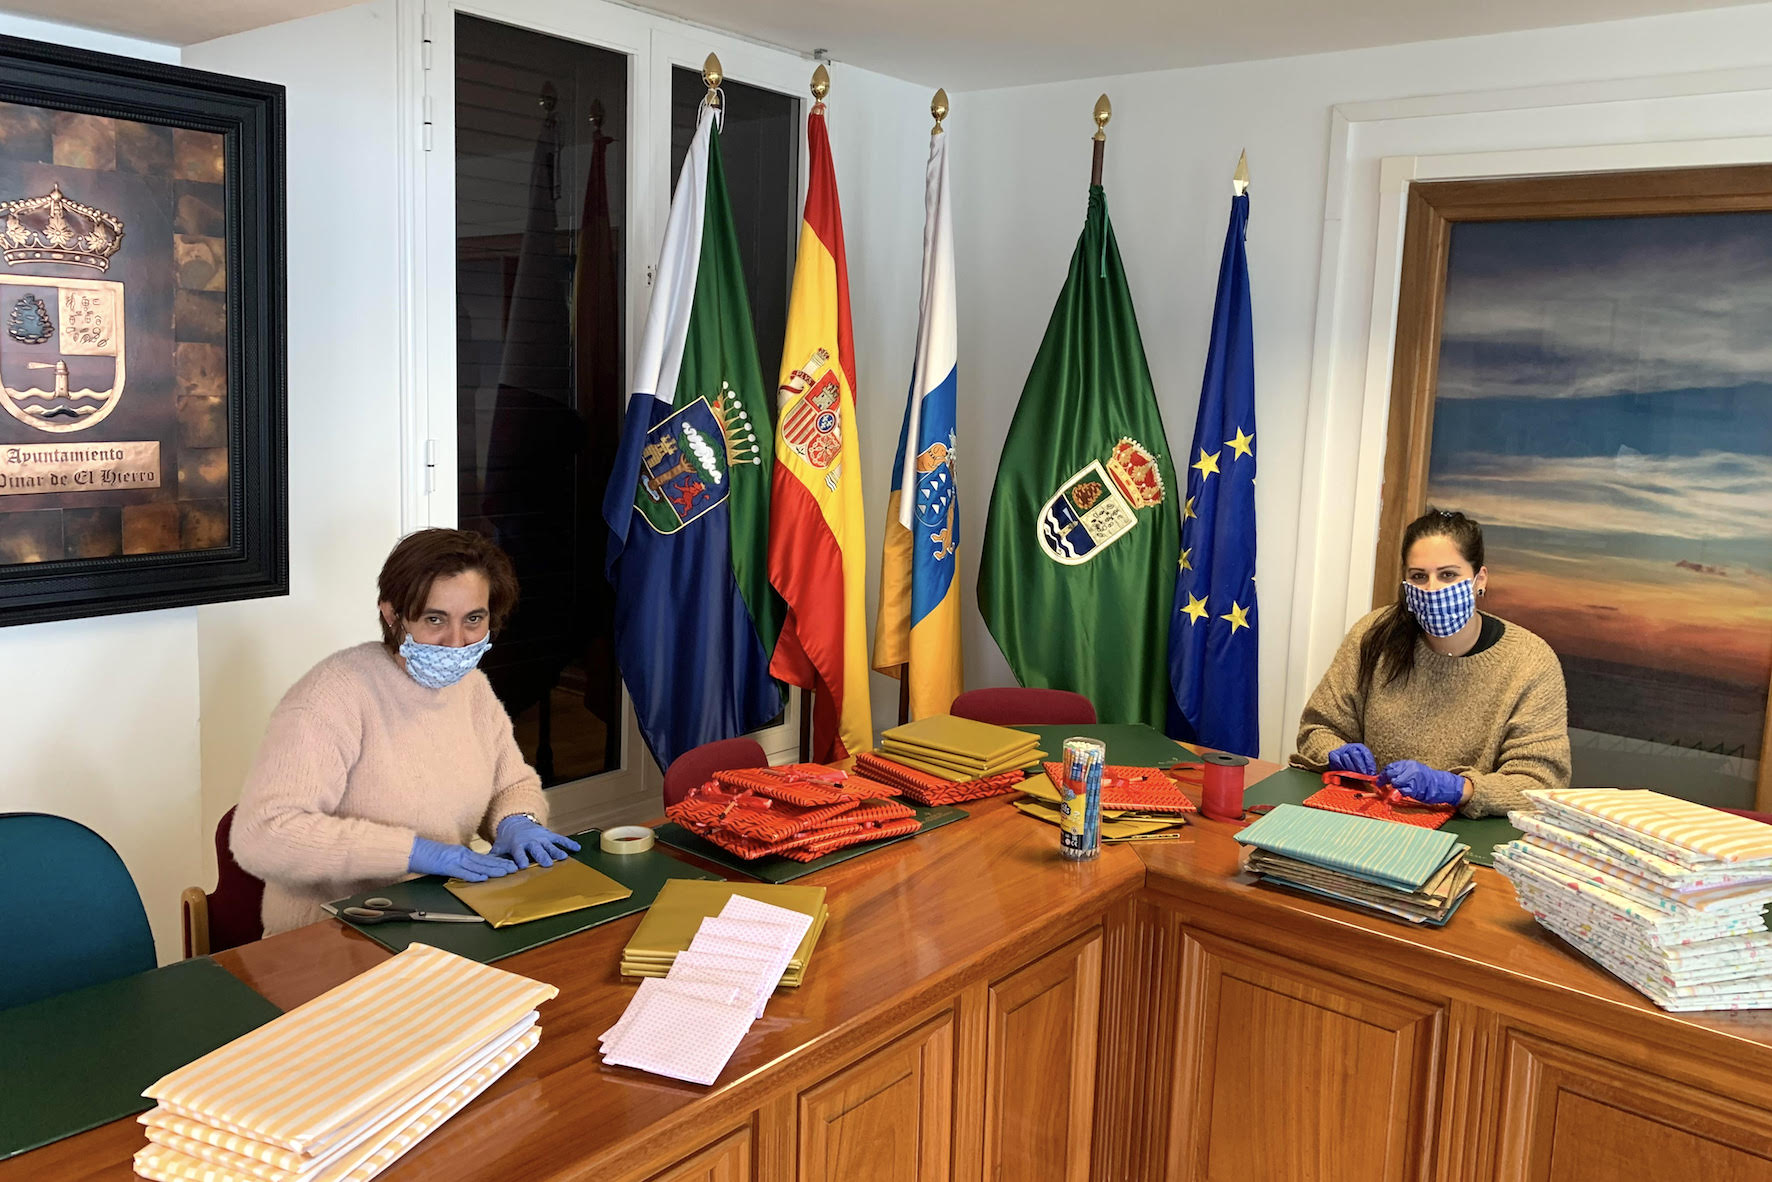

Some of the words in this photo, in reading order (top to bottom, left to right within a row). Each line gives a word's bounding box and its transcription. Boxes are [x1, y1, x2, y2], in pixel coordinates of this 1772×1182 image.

[7, 448, 124, 466] Ayuntamiento
[50, 473, 68, 486] de
[74, 470, 94, 485] El
[101, 469, 155, 487] Hierro
